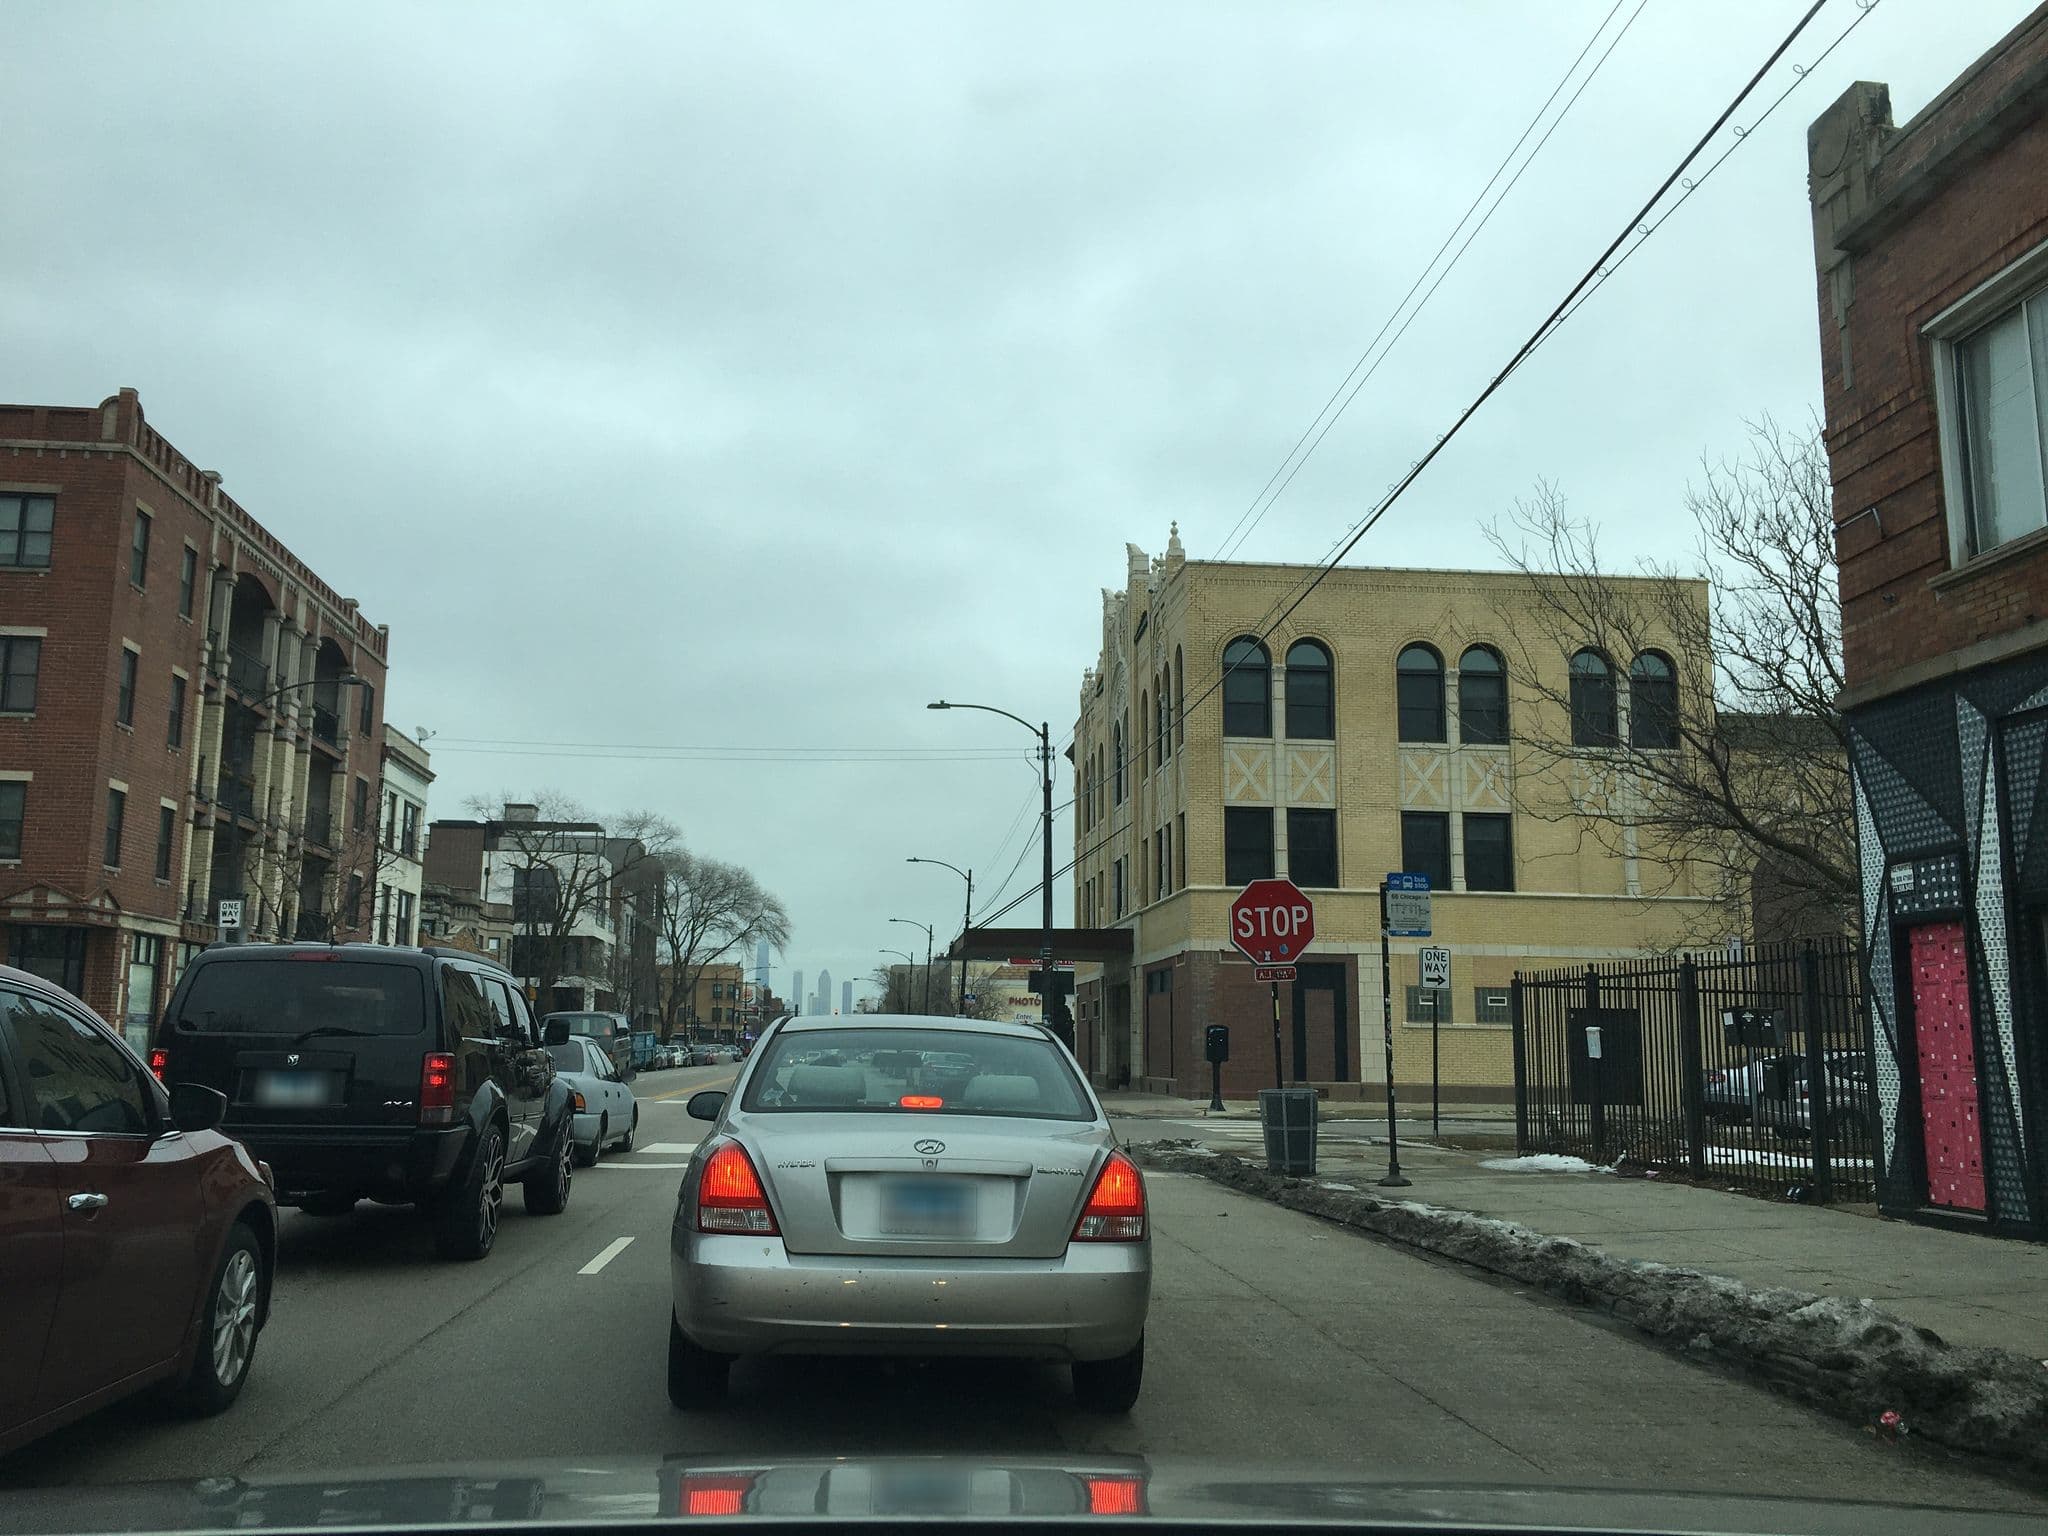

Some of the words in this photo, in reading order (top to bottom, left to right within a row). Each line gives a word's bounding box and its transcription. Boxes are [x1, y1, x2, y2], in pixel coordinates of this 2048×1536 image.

[222, 902, 240, 910] ONE
[1237, 905, 1309, 938] STOP
[1425, 951, 1447, 962] ONE
[1424, 962, 1448, 973] WAY
[1008, 996, 1041, 1007] PHOTO
